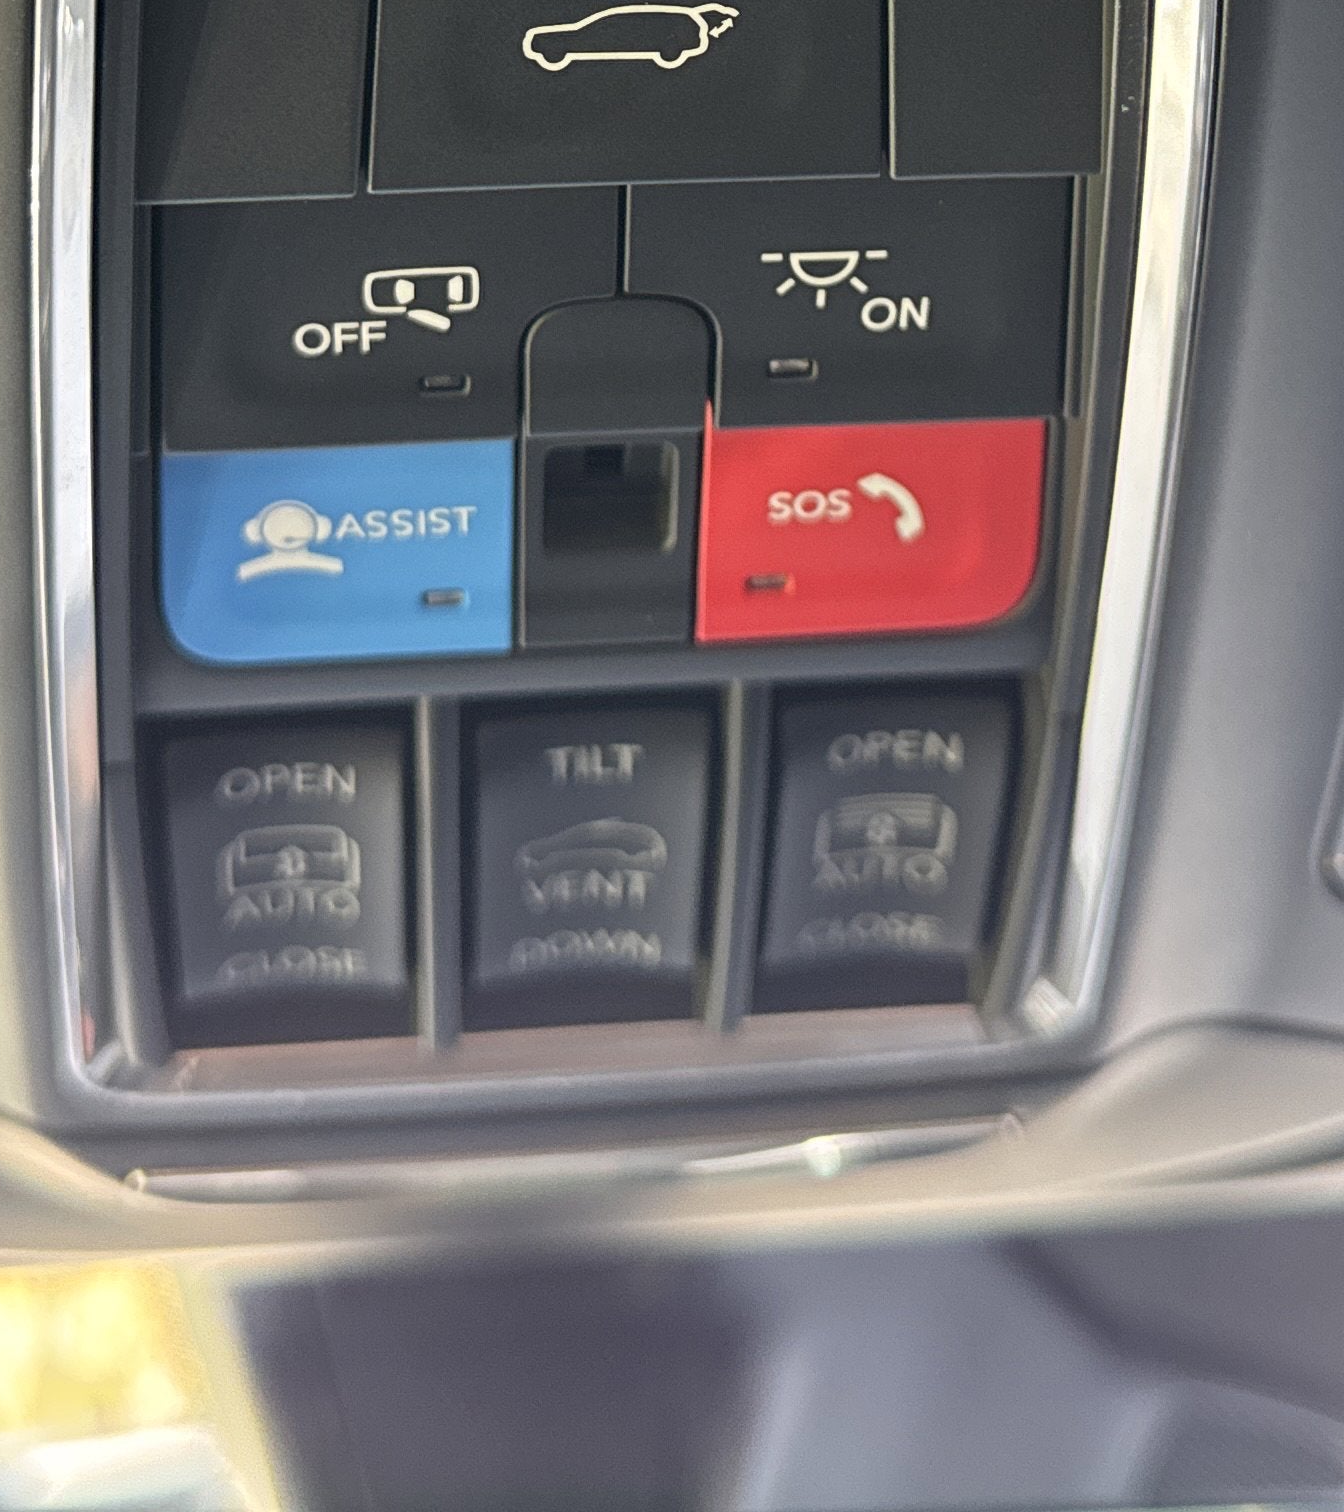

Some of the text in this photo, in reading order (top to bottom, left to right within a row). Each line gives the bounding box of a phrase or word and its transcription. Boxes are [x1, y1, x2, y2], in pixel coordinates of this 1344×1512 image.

[860, 296, 931, 333] ON
[293, 319, 387, 357] OFF
[335, 504, 478, 538] ASSIST
[767, 489, 853, 522] SOS
[545, 743, 644, 785] TILT
[828, 729, 964, 773] OPEN
[218, 762, 358, 803] OPEN
[224, 888, 361, 926] AUTO
